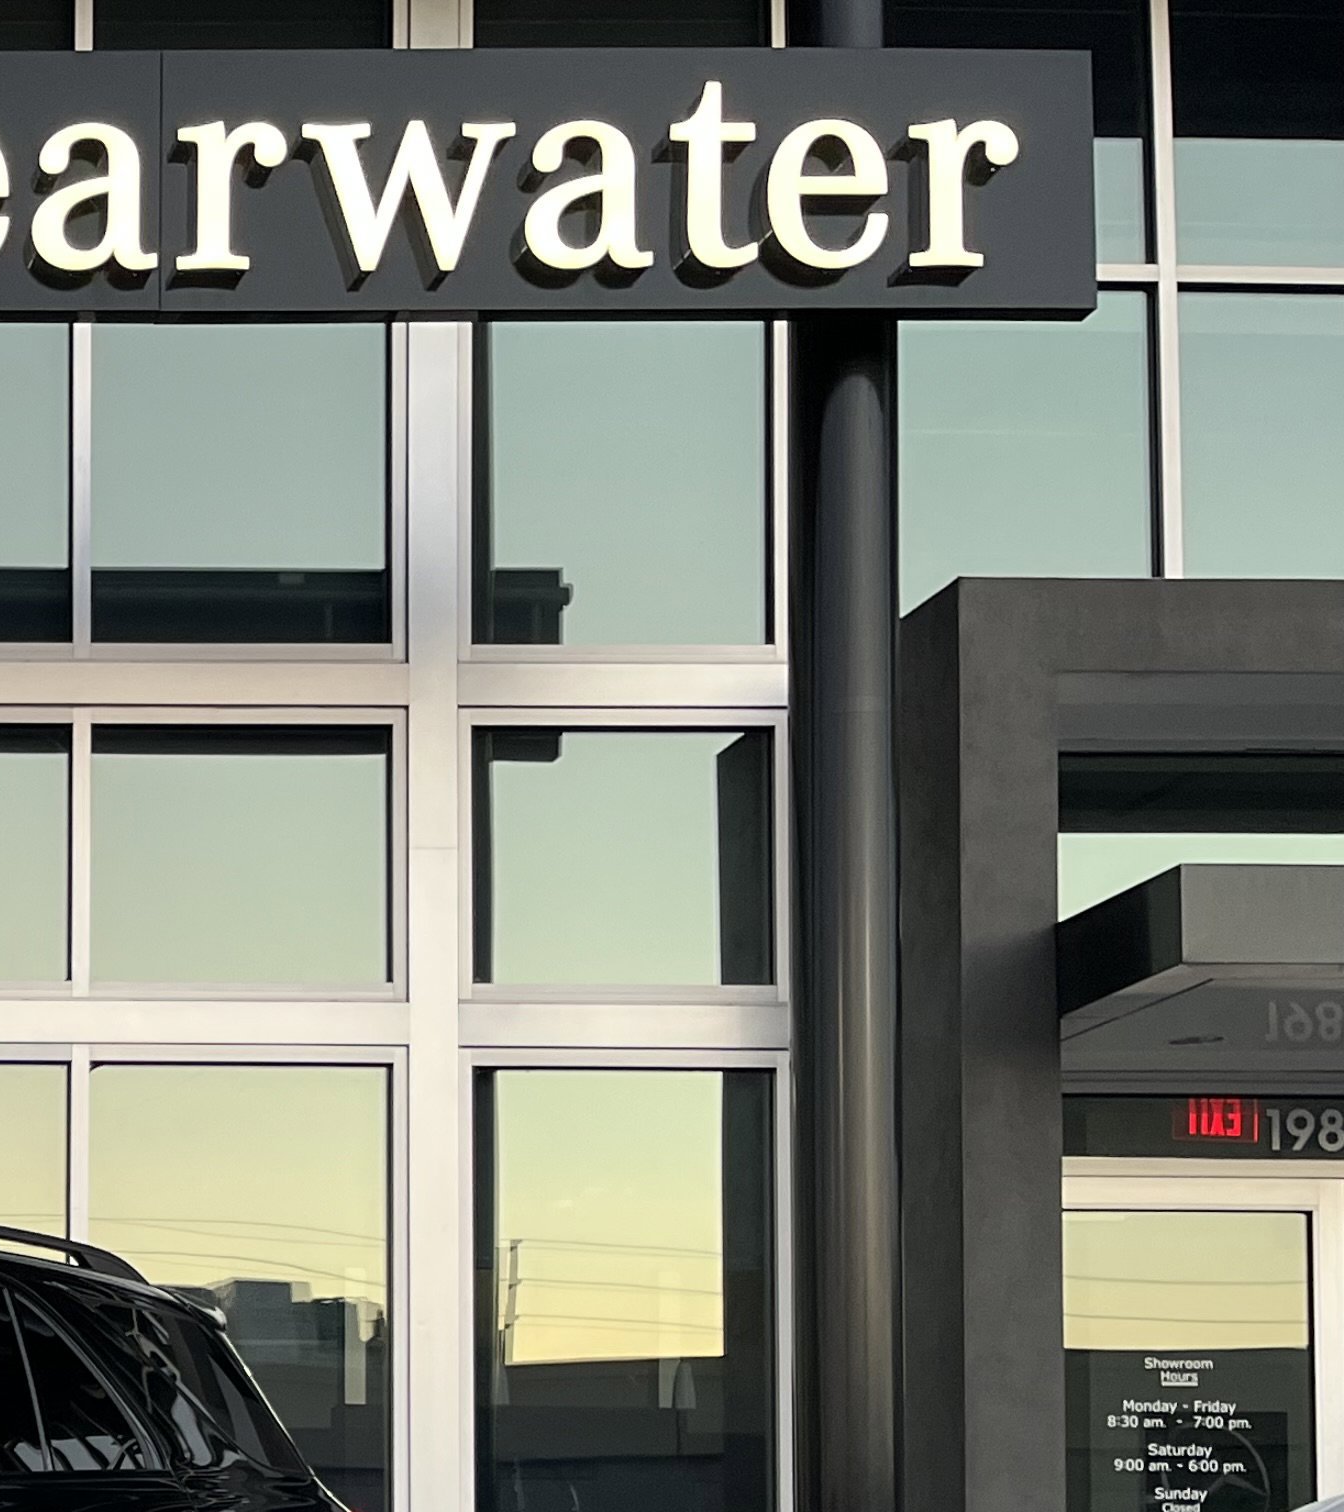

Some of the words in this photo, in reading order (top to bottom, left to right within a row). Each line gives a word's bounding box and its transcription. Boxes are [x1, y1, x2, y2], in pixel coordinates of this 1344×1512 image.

[1266, 1108, 1344, 1152] 198
[1144, 1357, 1213, 1369] Showroom
[1161, 1371, 1198, 1384] Hours
[1122, 1400, 1177, 1414] Monday
[1194, 1400, 1237, 1415] Friday
[1107, 1415, 1139, 1428] 8:30
[1143, 1418, 1167, 1428] am.
[1193, 1416, 1224, 1428] 7:00
[1147, 1443, 1212, 1459] Saturday
[1114, 1458, 1144, 1471] 9:00
[1148, 1461, 1172, 1472] am.
[1188, 1459, 1218, 1472] 6:00
[1154, 1487, 1208, 1503] Sunday
